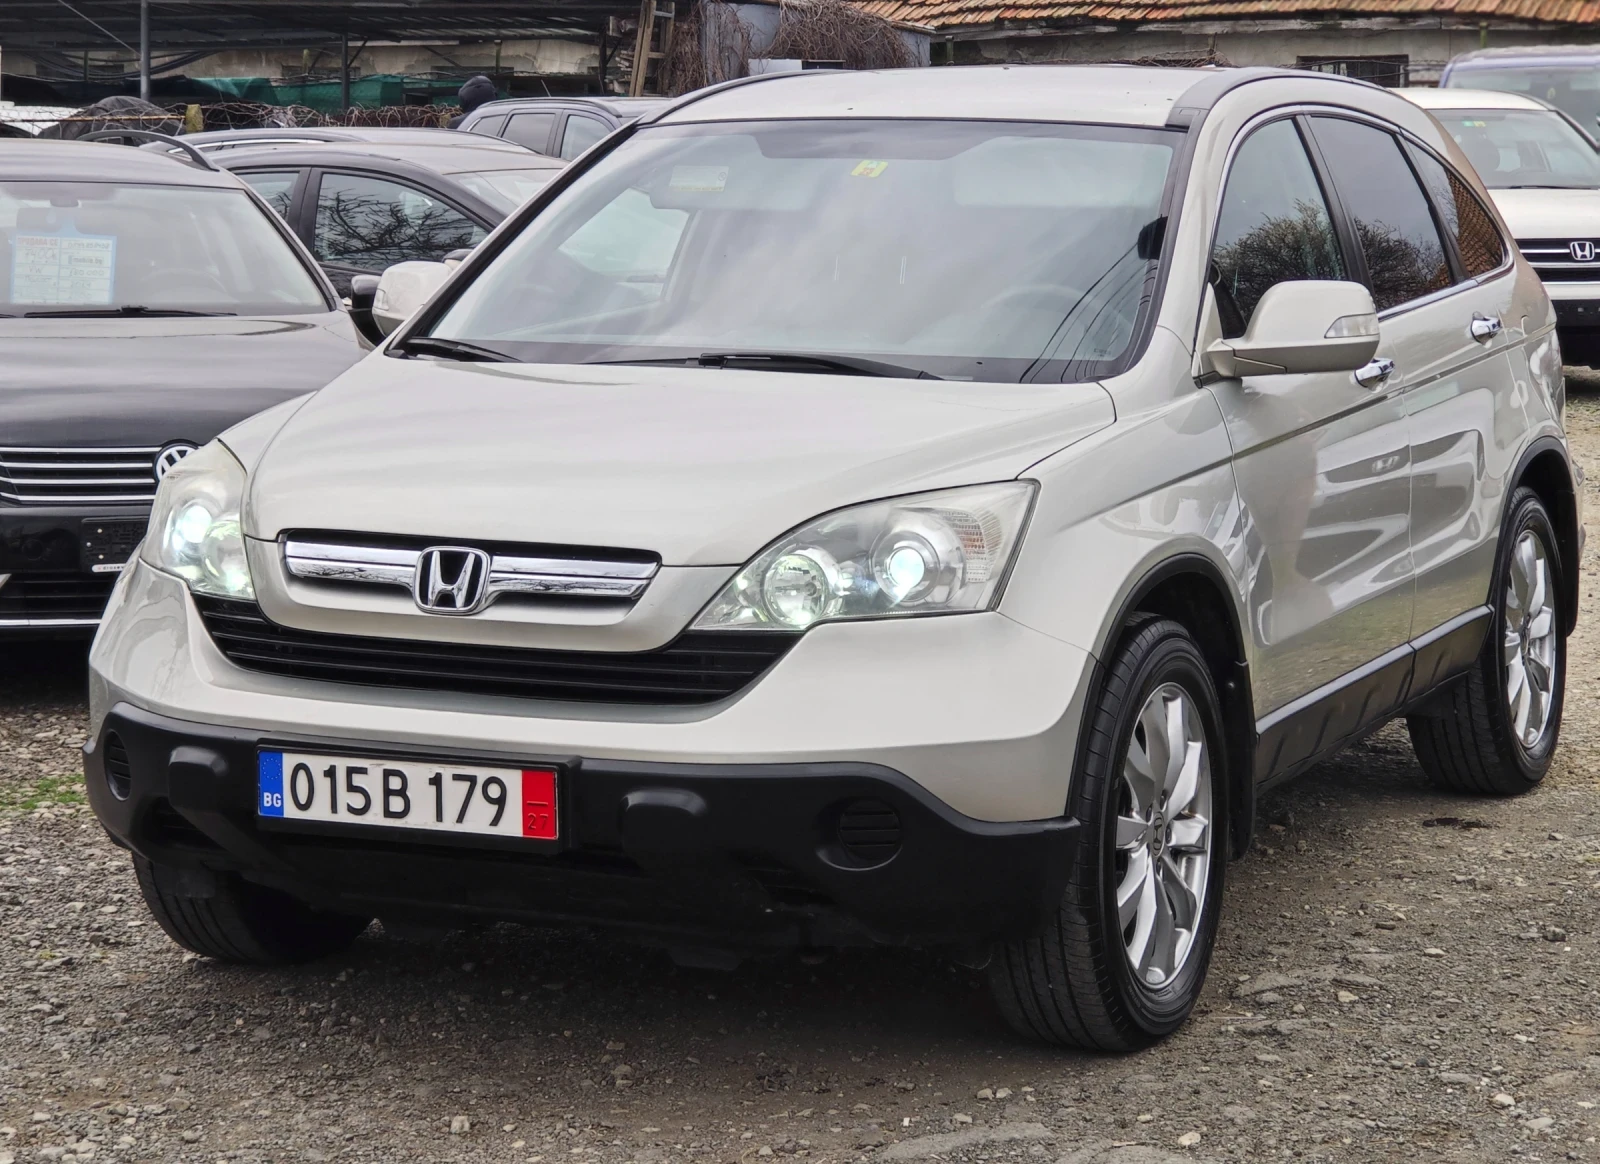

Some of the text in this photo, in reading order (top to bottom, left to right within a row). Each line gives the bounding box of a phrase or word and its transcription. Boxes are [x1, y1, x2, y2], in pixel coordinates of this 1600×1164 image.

[426, 549, 477, 610] H
[263, 792, 282, 808] BG
[290, 762, 507, 827] 015B 179
[527, 812, 549, 830] 27
